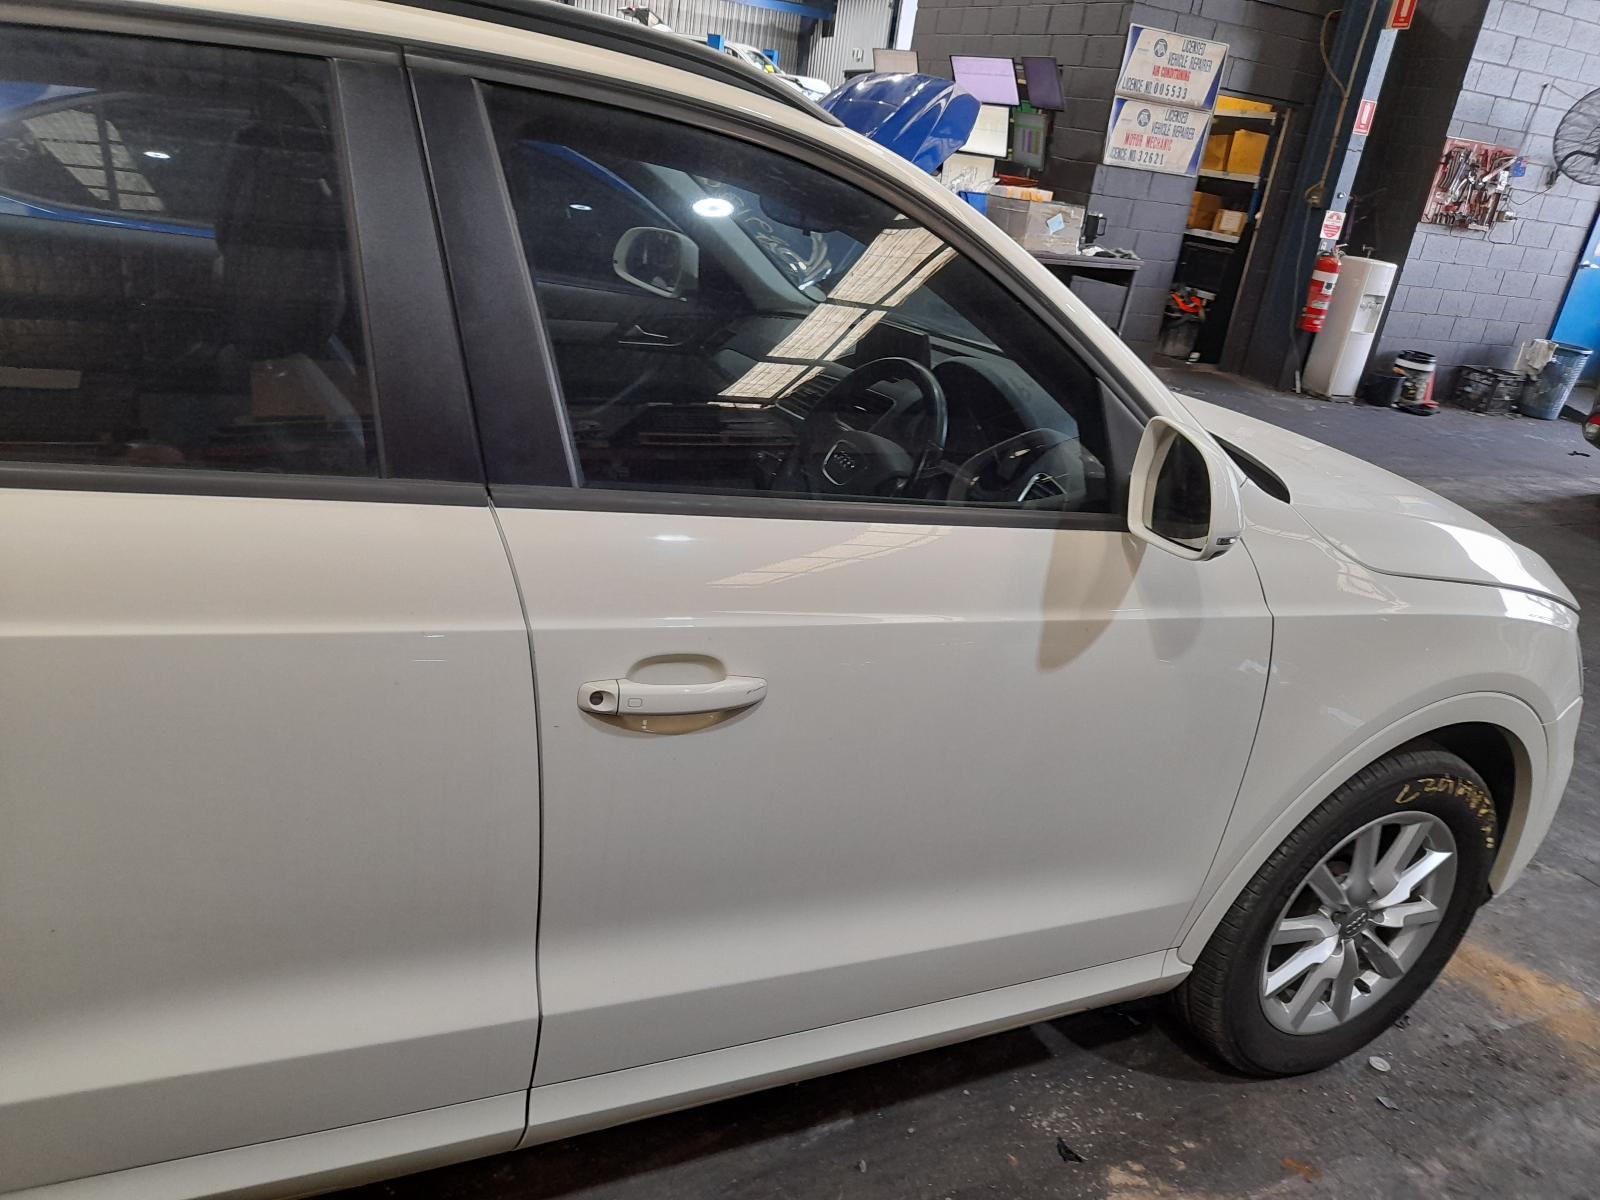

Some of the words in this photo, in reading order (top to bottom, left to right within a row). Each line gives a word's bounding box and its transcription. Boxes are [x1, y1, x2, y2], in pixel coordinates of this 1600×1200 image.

[1168, 52, 1188, 68] VEHICLE
[1189, 56, 1212, 72] REPAIRER
[1153, 82, 1188, 99] 005533
[1152, 122, 1172, 136] VEHICLE
[1172, 125, 1195, 140] REPAIRER
[1124, 132, 1143, 146] MOTOR
[1145, 136, 1173, 151] MECHANIC
[1138, 150, 1164, 165] 32621
